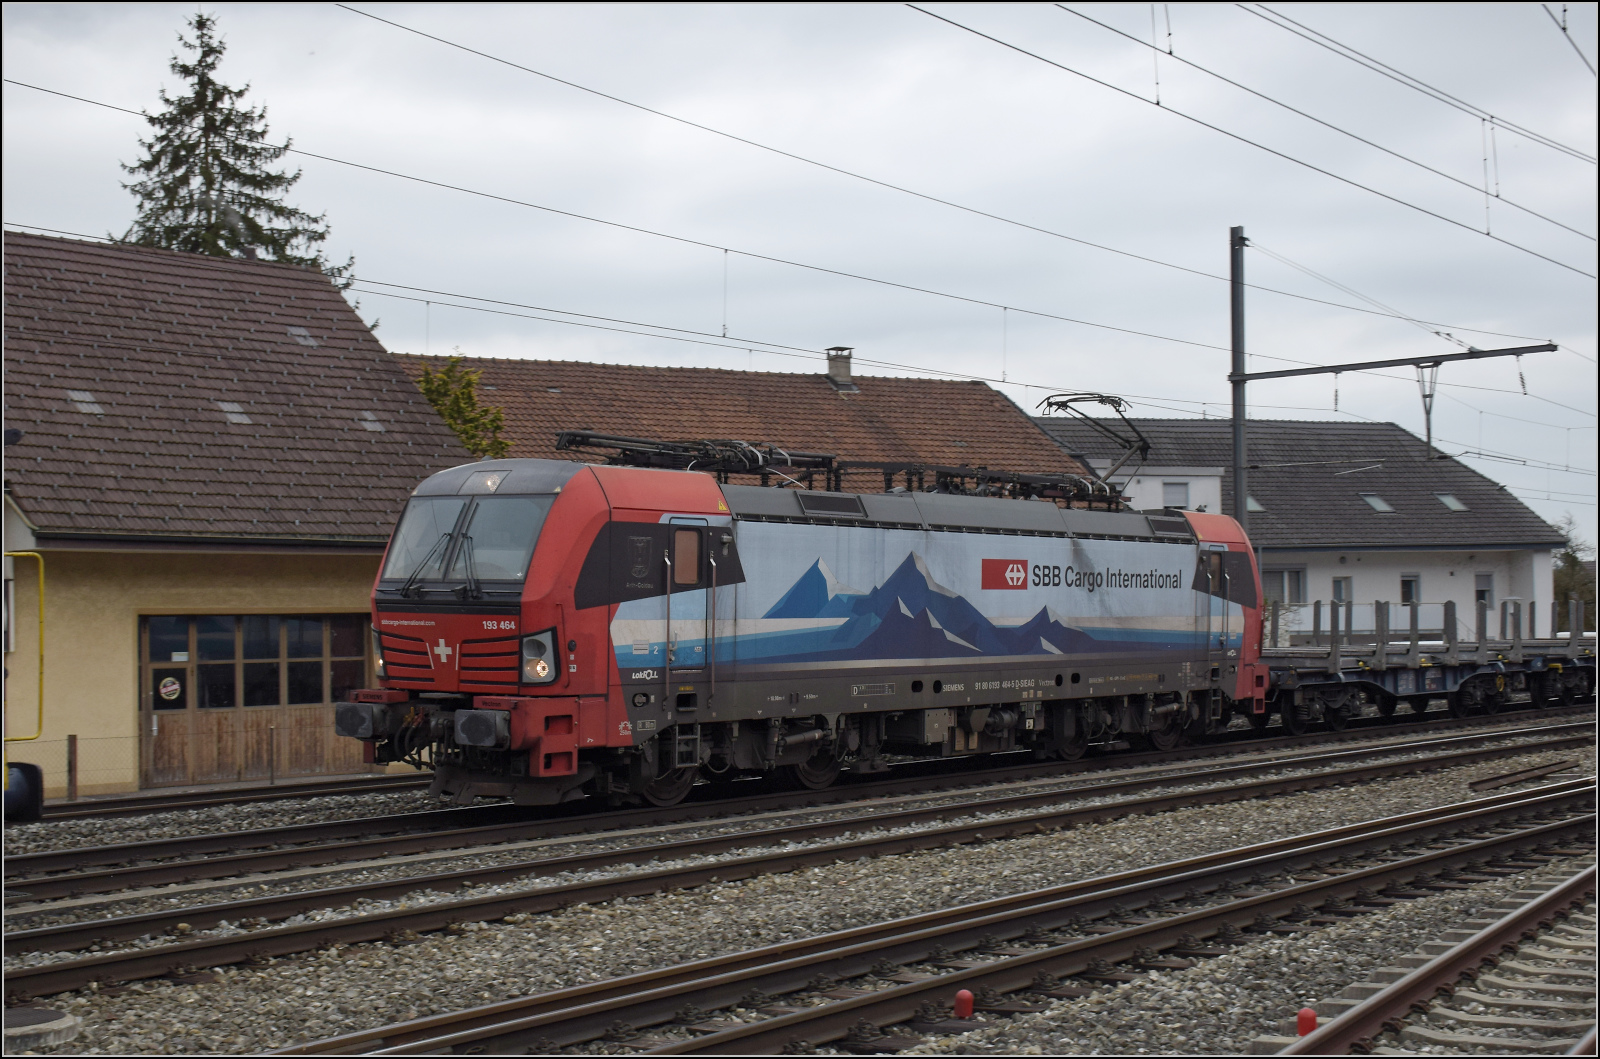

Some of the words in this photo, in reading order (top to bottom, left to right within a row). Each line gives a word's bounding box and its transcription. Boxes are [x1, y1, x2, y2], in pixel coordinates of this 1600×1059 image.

[1032, 565, 1061, 587] SBB
[1064, 566, 1103, 593] Cargo
[1106, 567, 1182, 589] International
[482, 620, 498, 630] 193
[499, 621, 516, 630] 464
[653, 645, 659, 655] 2
[942, 683, 965, 692] SIEMENS
[974, 682, 981, 690] 91
[981, 681, 989, 690] 80
[988, 681, 1001, 690] 6193
